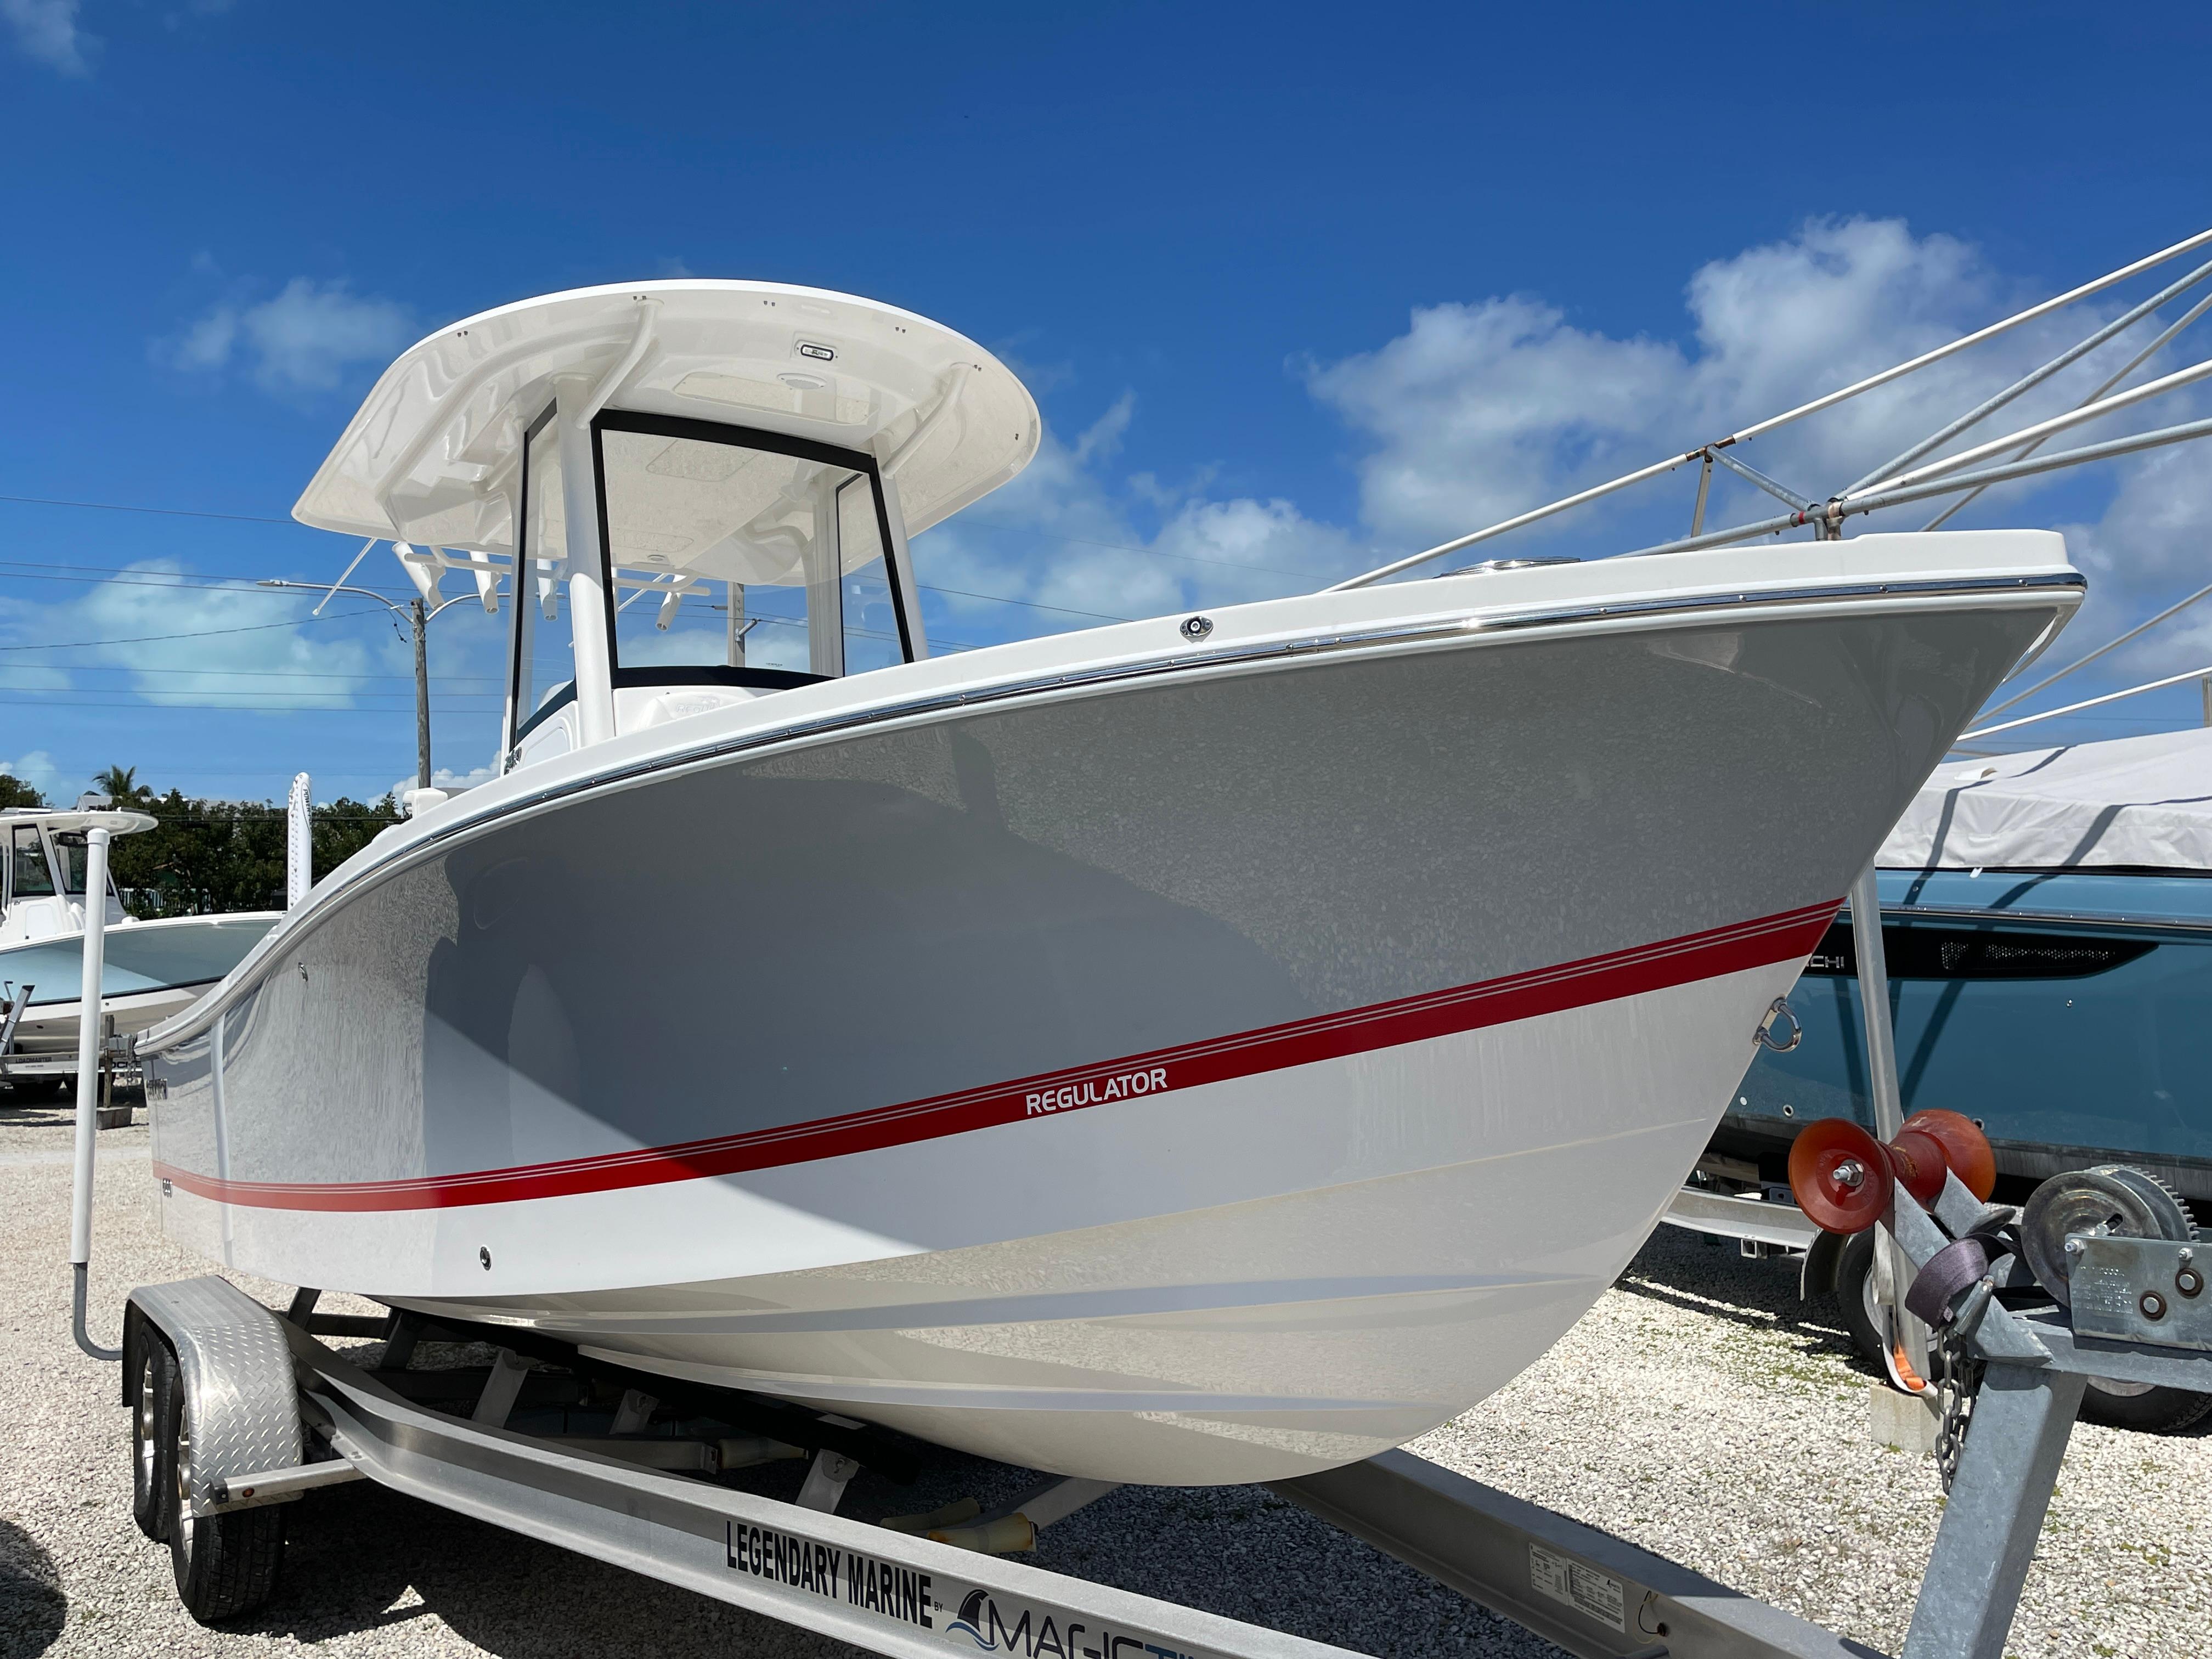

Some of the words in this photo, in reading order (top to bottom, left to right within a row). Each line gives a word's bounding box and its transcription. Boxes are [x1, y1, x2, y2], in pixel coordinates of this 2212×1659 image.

[1805, 955, 1844, 969] CHI
[1026, 1068, 1167, 1115] REGULATOR
[727, 1520, 840, 1599] LEGENDARY
[848, 1554, 933, 1629] MARINE
[934, 1602, 943, 1612] BY
